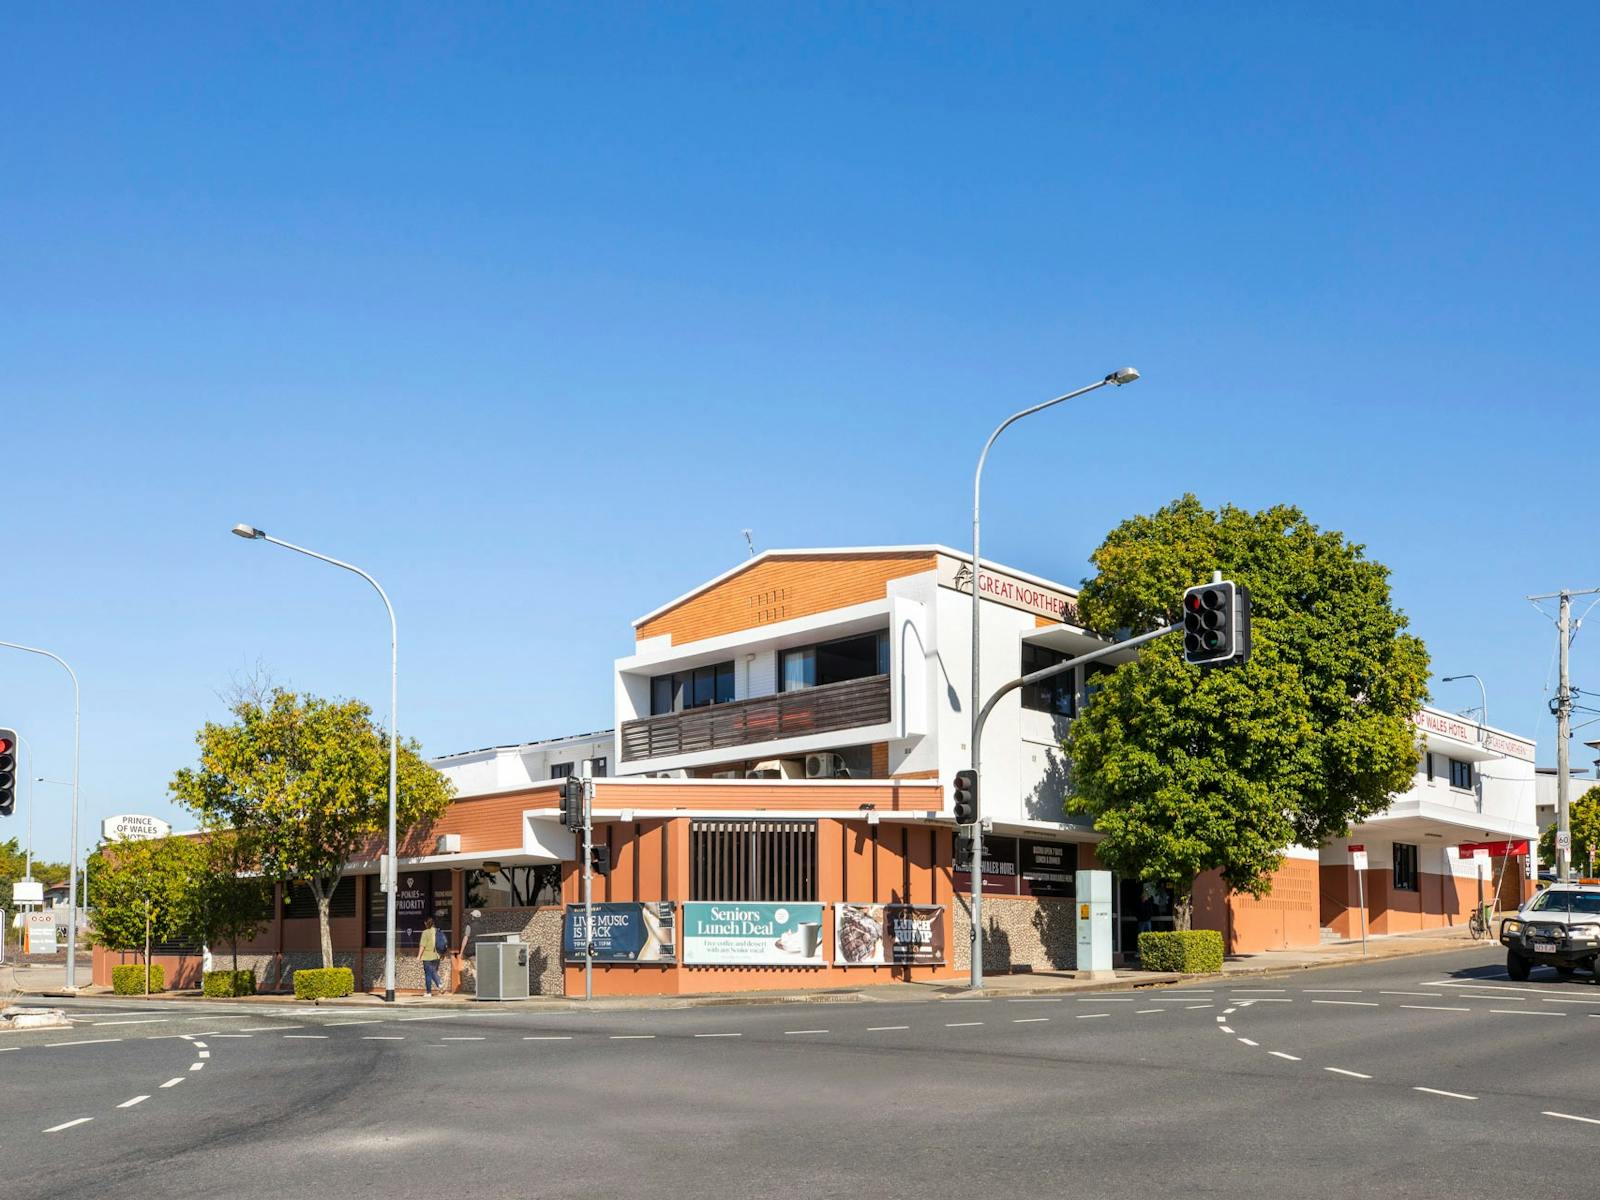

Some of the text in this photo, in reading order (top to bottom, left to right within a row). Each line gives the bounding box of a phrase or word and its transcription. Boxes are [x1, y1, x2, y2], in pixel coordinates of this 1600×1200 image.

[978, 574, 1014, 599] GREAT
[1427, 716, 1447, 733] WALES
[1449, 722, 1468, 740] HOTEL
[122, 816, 152, 826] PRINCE
[117, 824, 158, 834] OF WALES
[1559, 836, 1569, 844] 60
[999, 861, 1016, 876] HOTEL
[573, 914, 629, 927] LIVE MUSIC
[711, 906, 760, 922] Seniors
[697, 921, 774, 936] Lunch Deal
[893, 918, 932, 930] LUNCH
[573, 927, 582, 939] IS
[894, 929, 934, 943] RUMP
